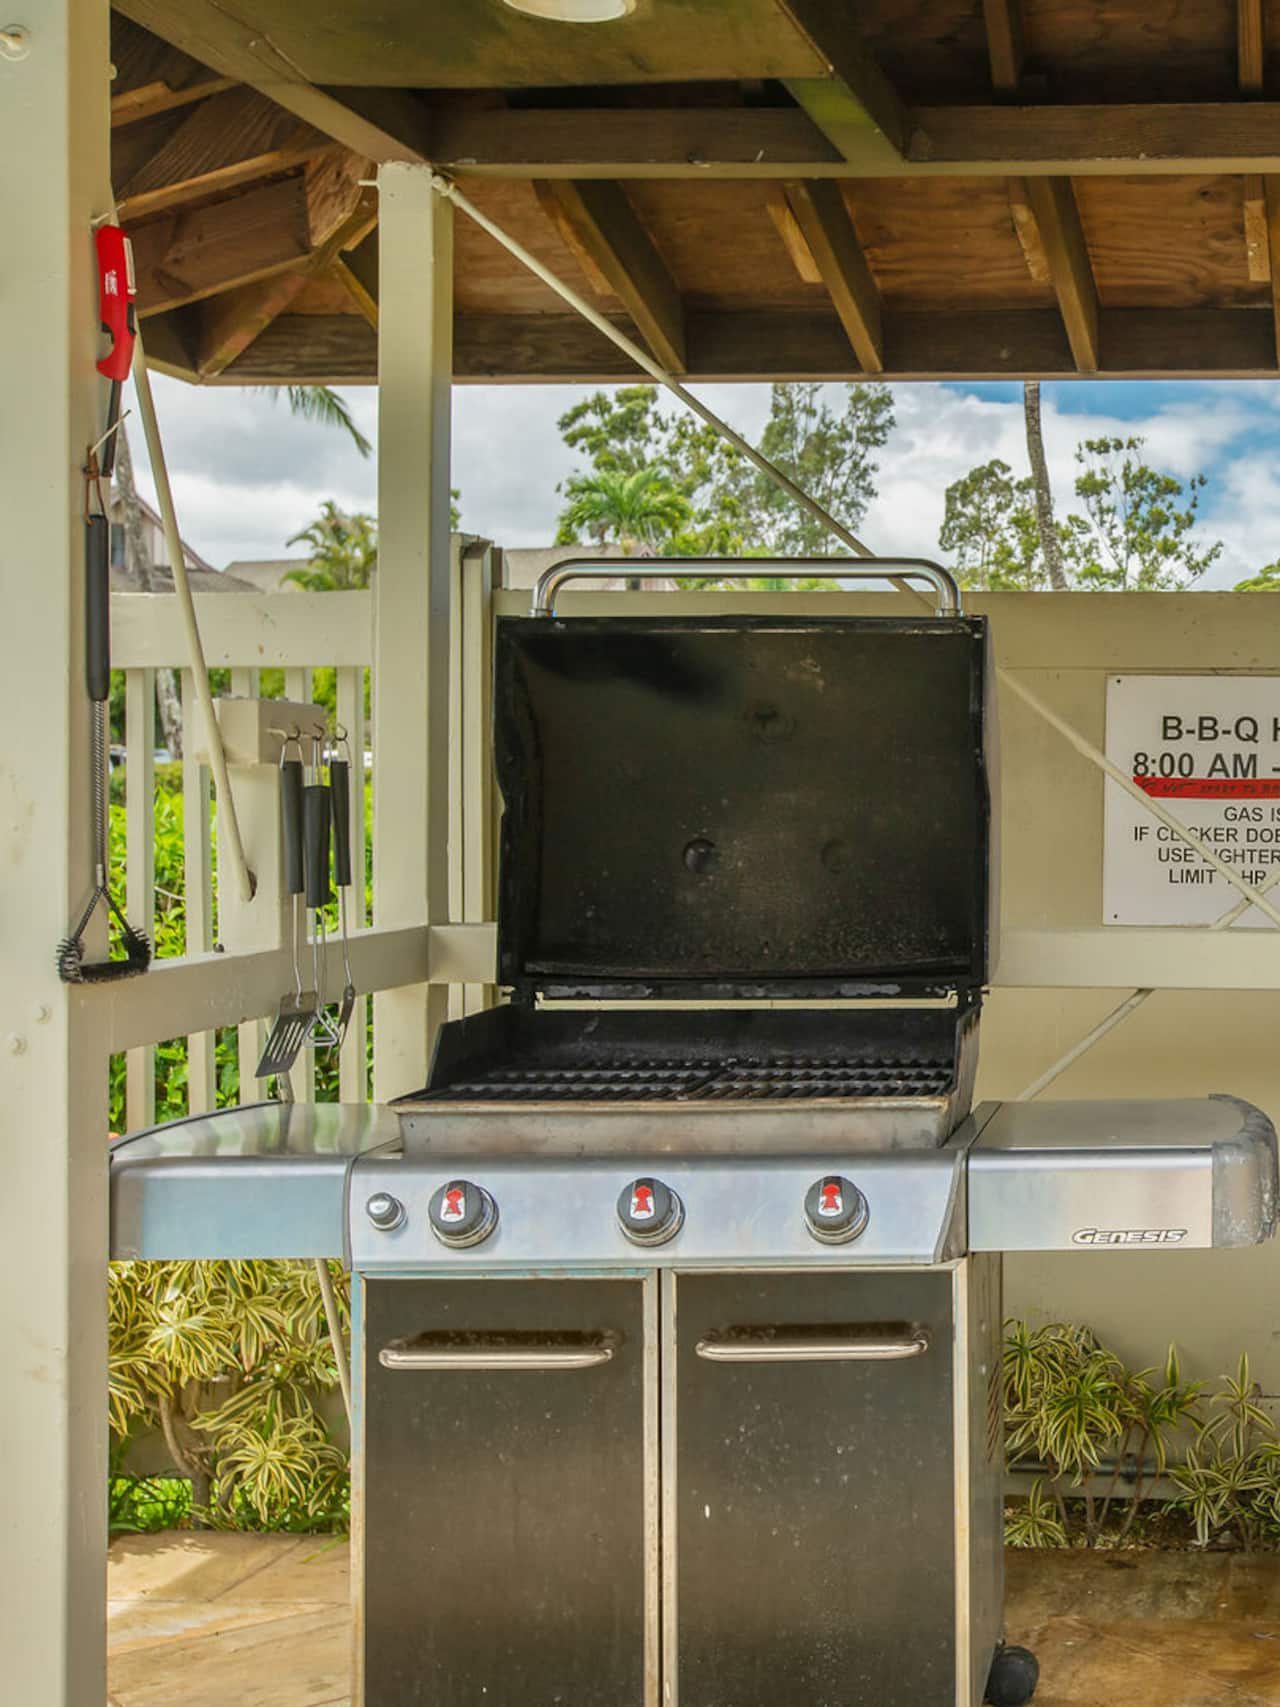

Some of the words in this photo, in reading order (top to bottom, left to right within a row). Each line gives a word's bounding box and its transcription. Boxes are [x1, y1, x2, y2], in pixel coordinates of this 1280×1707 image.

[1161, 715, 1259, 743] B-B-Q
[1132, 751, 1194, 778] 8:00
[1206, 752, 1257, 778] AM
[1223, 806, 1264, 822] GAS
[1133, 826, 1150, 841] IF
[1156, 826, 1239, 843] CLKER
[1157, 847, 1195, 863] USE
[1168, 868, 1217, 884] LIMIT
[1241, 870, 1267, 885] HR
[1072, 1228, 1188, 1244] GENESIS
